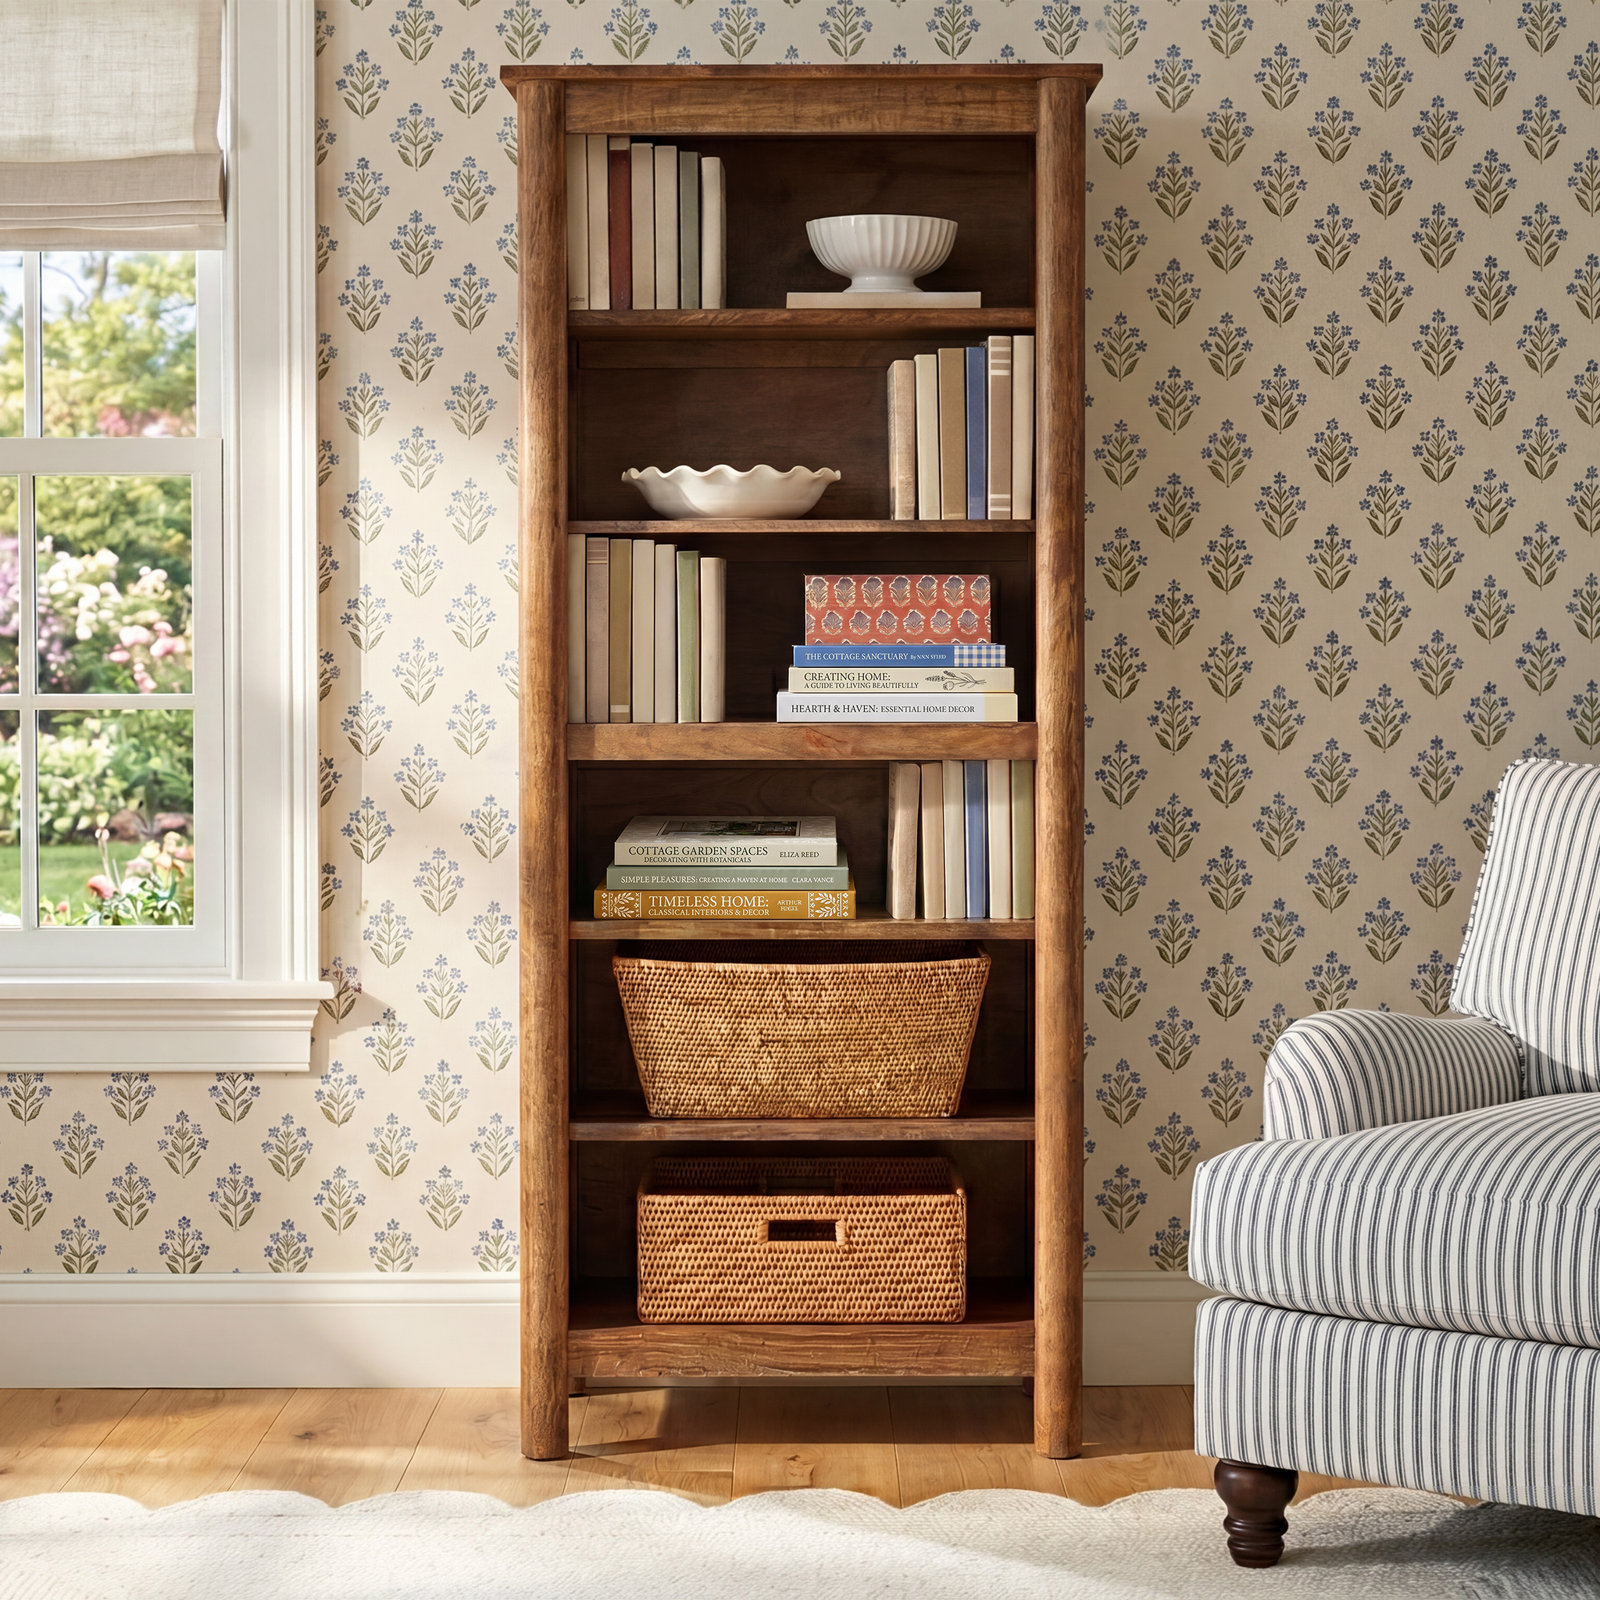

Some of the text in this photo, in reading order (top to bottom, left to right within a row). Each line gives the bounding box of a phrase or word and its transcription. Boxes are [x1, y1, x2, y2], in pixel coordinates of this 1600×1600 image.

[804, 672, 891, 681] CREATING HOME:
[791, 704, 975, 713] HEARTH & HAVEN: ESSENTIAL HOME DECOR
[628, 846, 768, 856] COTTAGE GARDEN SPACES
[620, 876, 650, 884] SIMPLE
[651, 876, 698, 884] PLEASURES:
[648, 895, 769, 908] TIMELESS HOME:
[648, 908, 770, 916] CLASSICAL INTERIORS & DECOR
